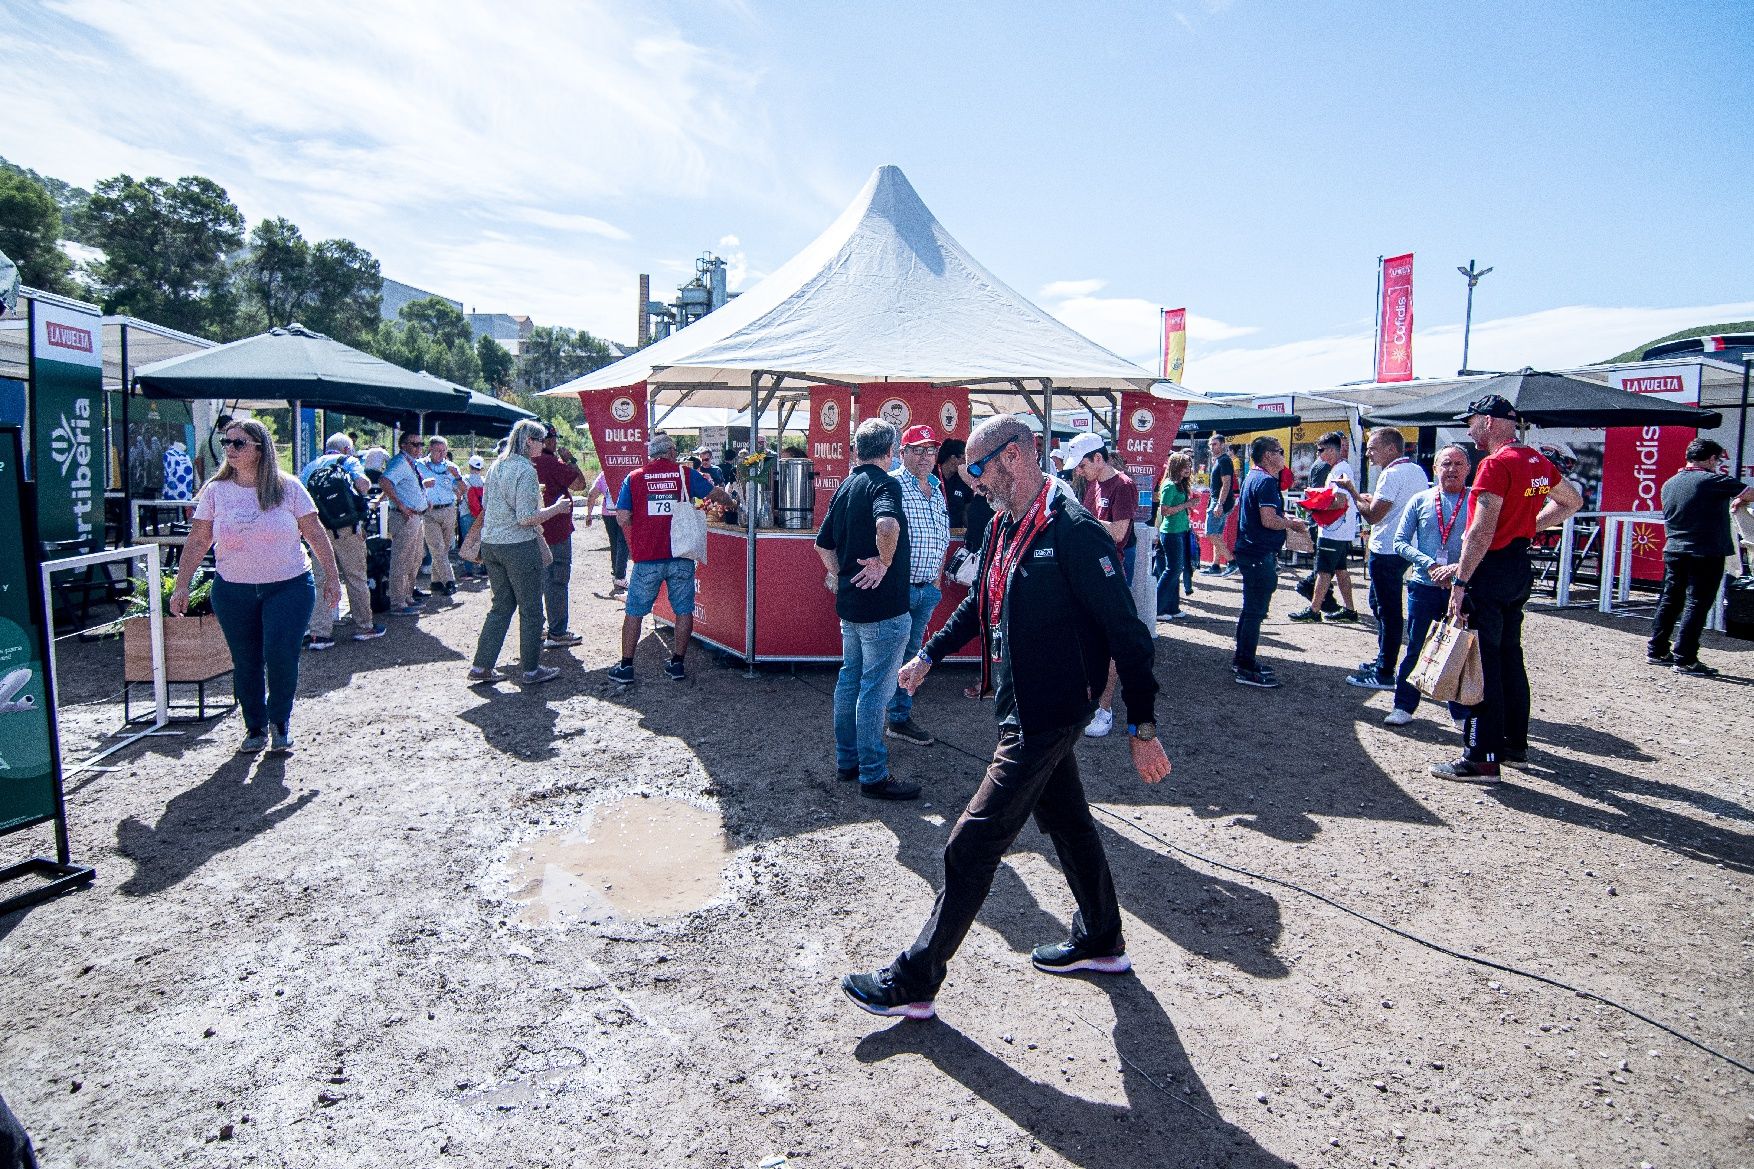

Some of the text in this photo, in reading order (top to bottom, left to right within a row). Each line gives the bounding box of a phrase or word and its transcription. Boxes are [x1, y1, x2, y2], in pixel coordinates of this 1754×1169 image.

[1394, 297, 1406, 345] Cofidis
[61, 328, 90, 350] VUELTA
[1626, 378, 1679, 392] LA VUELTA
[605, 428, 642, 442] DULCE
[814, 443, 842, 459] DULCE
[1127, 437, 1154, 453] CAFÉ
[617, 456, 641, 465] VUELTA
[644, 472, 680, 480] SHIMANO
[70, 398, 93, 574] rtiberia
[655, 501, 672, 513] 78
